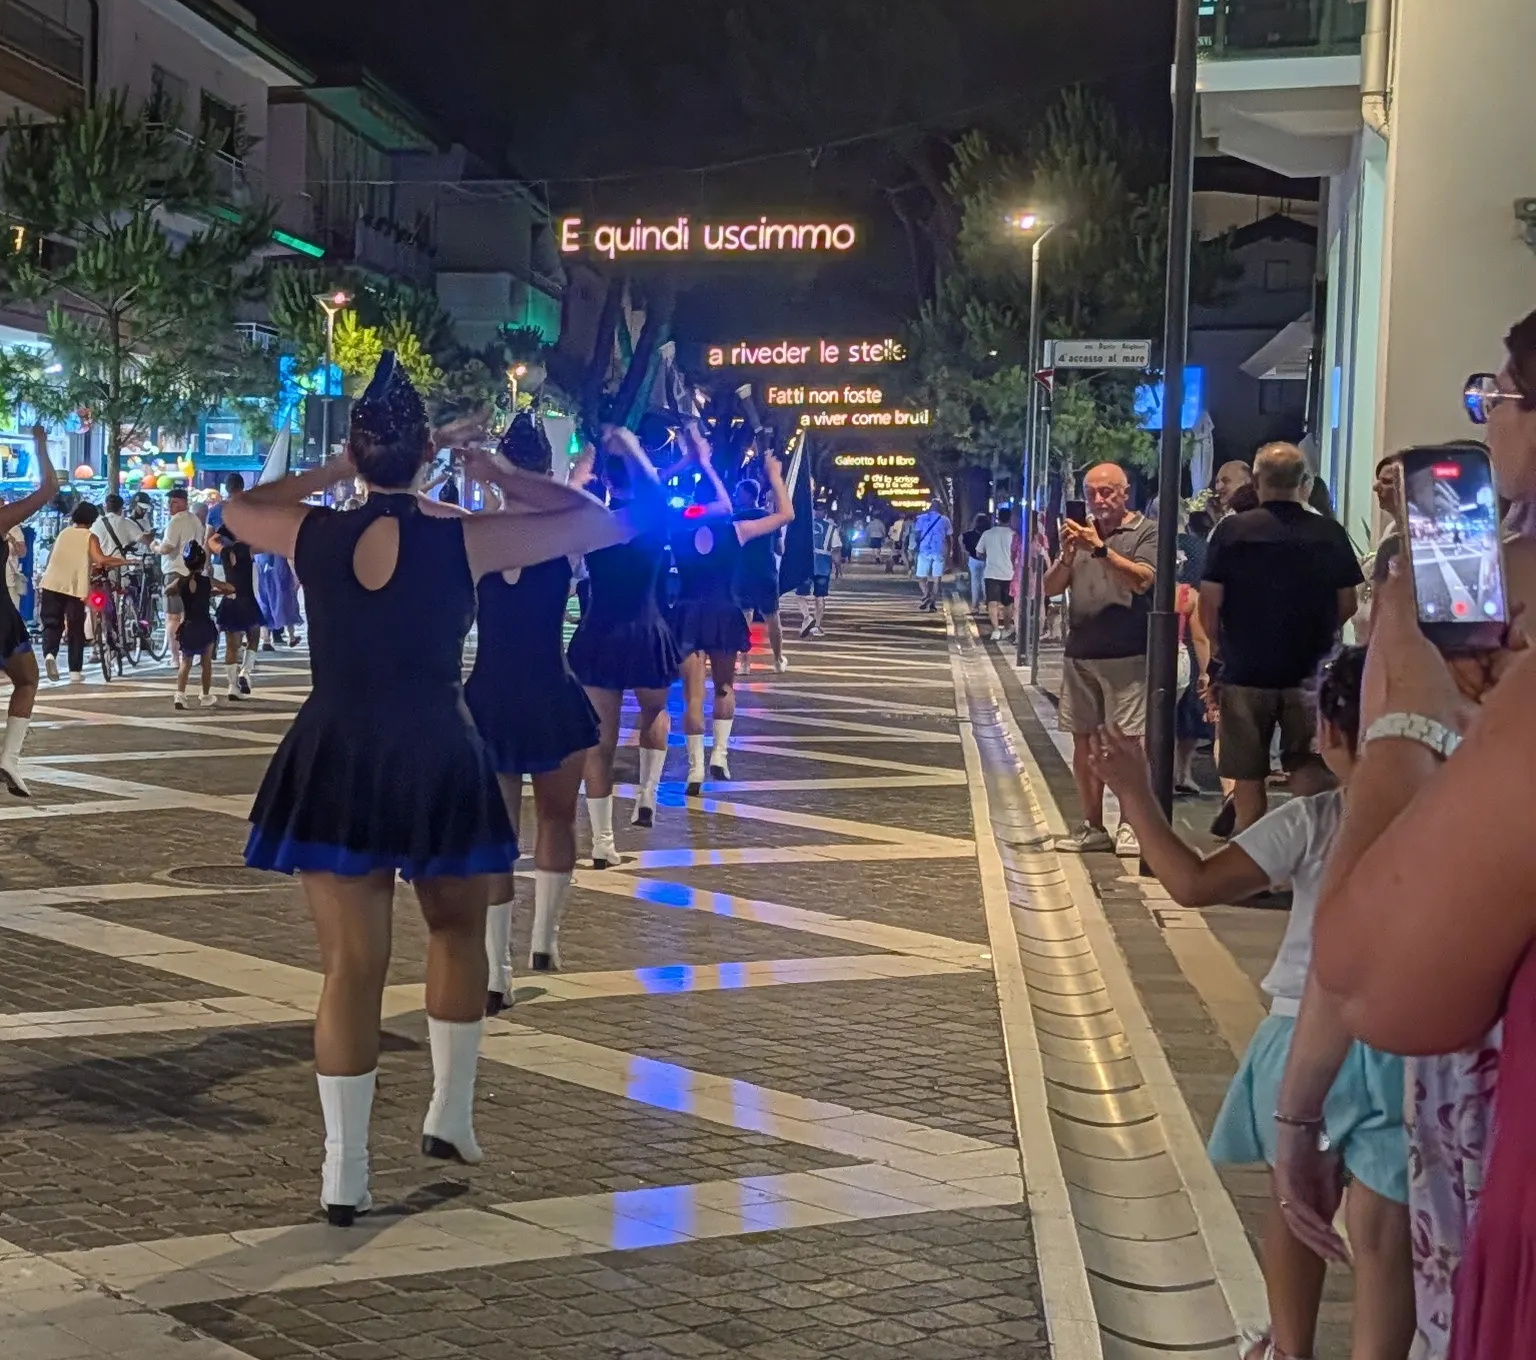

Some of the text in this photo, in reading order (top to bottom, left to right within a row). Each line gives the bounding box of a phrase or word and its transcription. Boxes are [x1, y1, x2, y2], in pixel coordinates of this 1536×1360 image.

[561, 216, 856, 260] E quindi uscimmo
[708, 347, 723, 366] a
[731, 340, 811, 365] riveder
[819, 340, 840, 363] le
[1068, 354, 1104, 363] accesso
[1107, 354, 1117, 363] al
[1122, 354, 1145, 363] mare
[767, 386, 882, 405] Fatti non foste
[800, 414, 810, 426] a
[814, 411, 848, 426] viver
[851, 413, 891, 425] come
